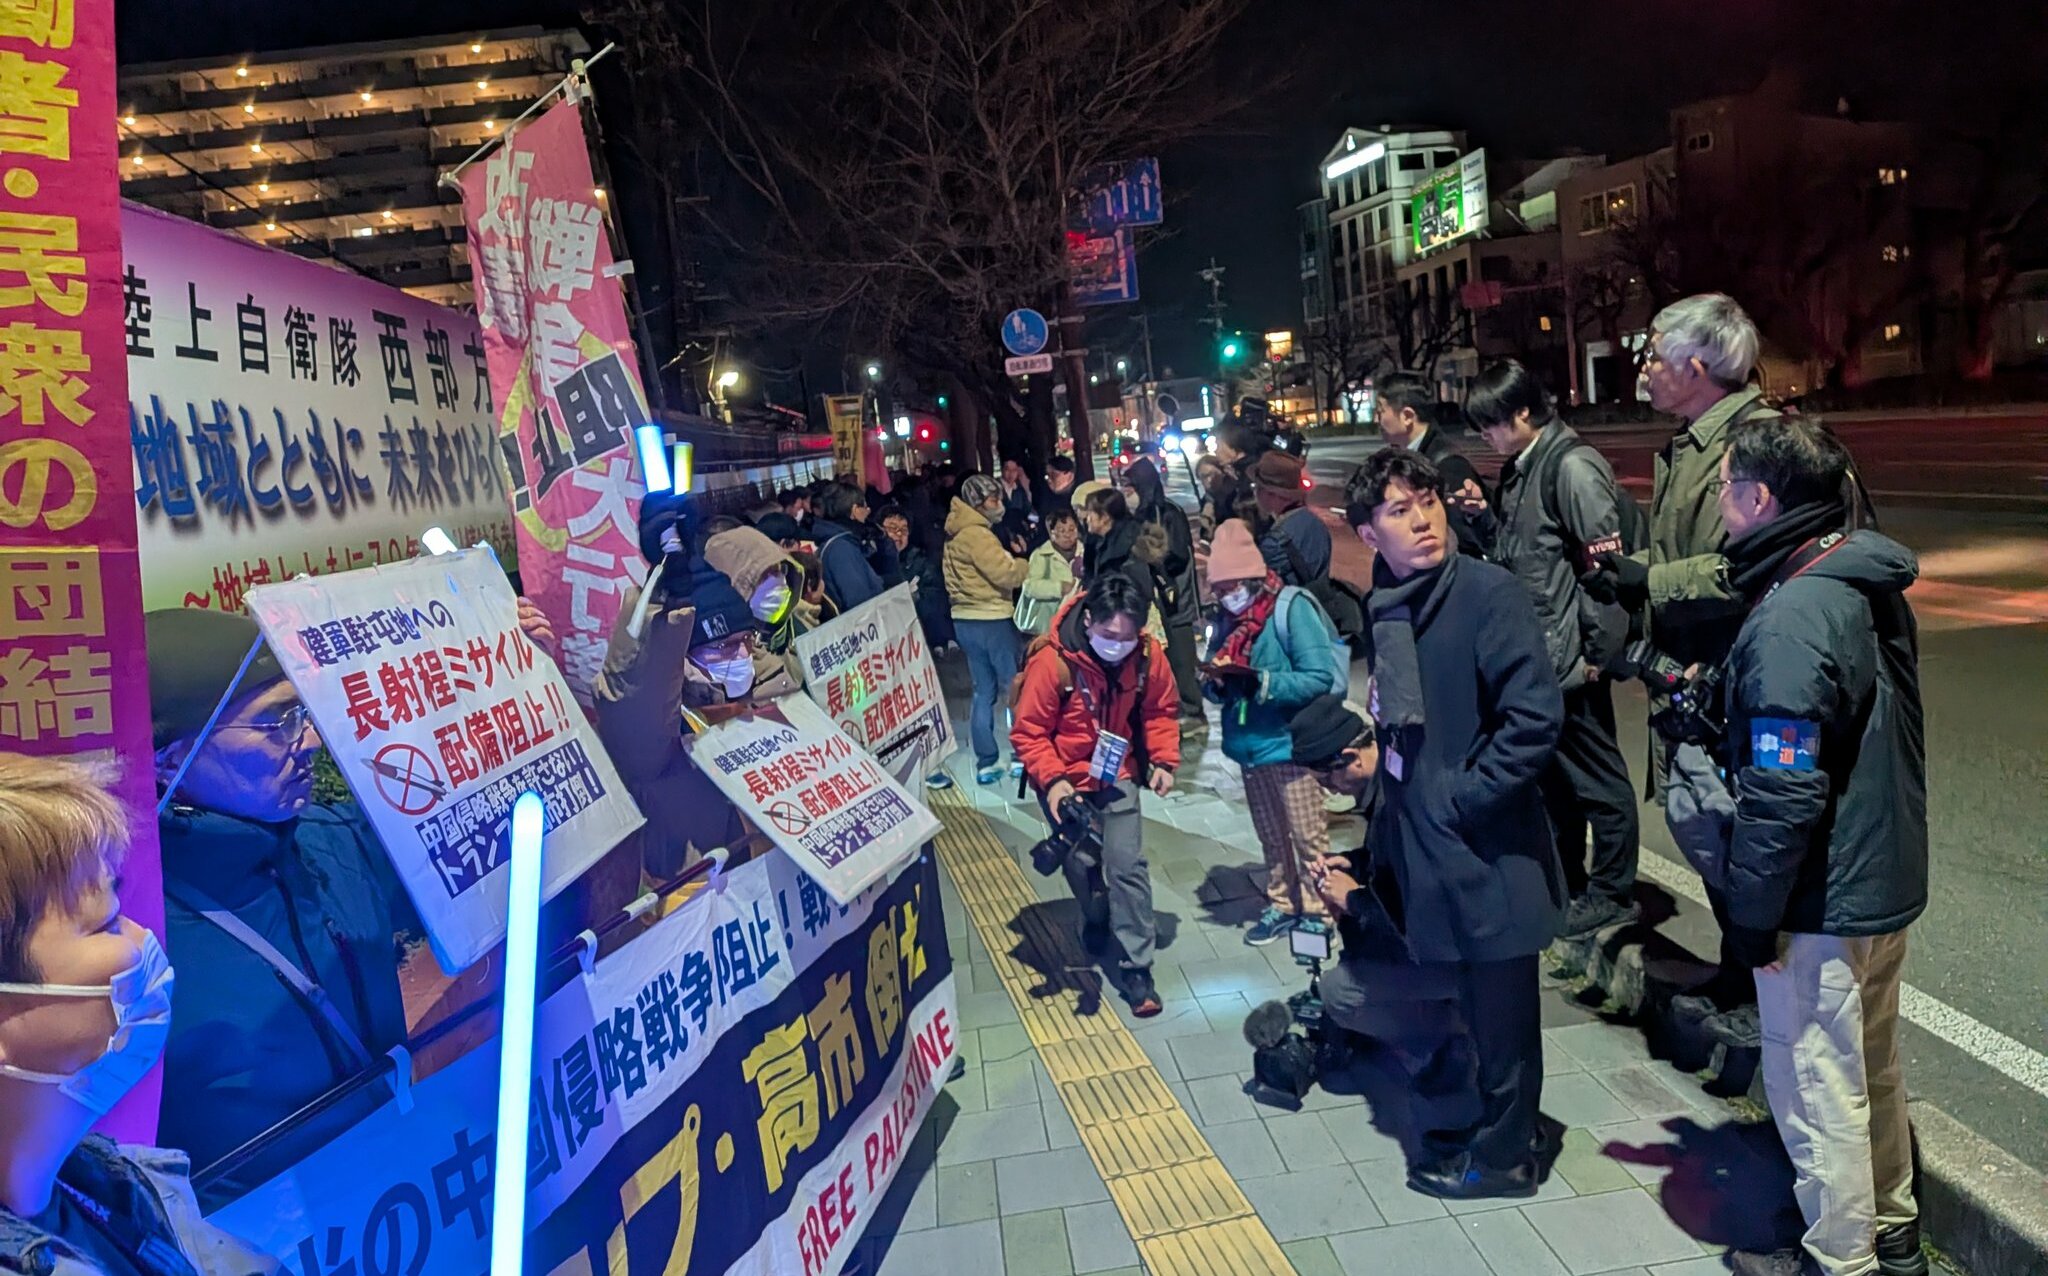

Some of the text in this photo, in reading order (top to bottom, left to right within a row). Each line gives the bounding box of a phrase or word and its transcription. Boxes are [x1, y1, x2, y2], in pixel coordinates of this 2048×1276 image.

[341, 627, 533, 742] 長射程ミサイル
[827, 630, 921, 720] 長射程ミサイル
[742, 733, 853, 804] 長射程ミサイル
[797, 1007, 956, 1276] FREE PALESTINE
